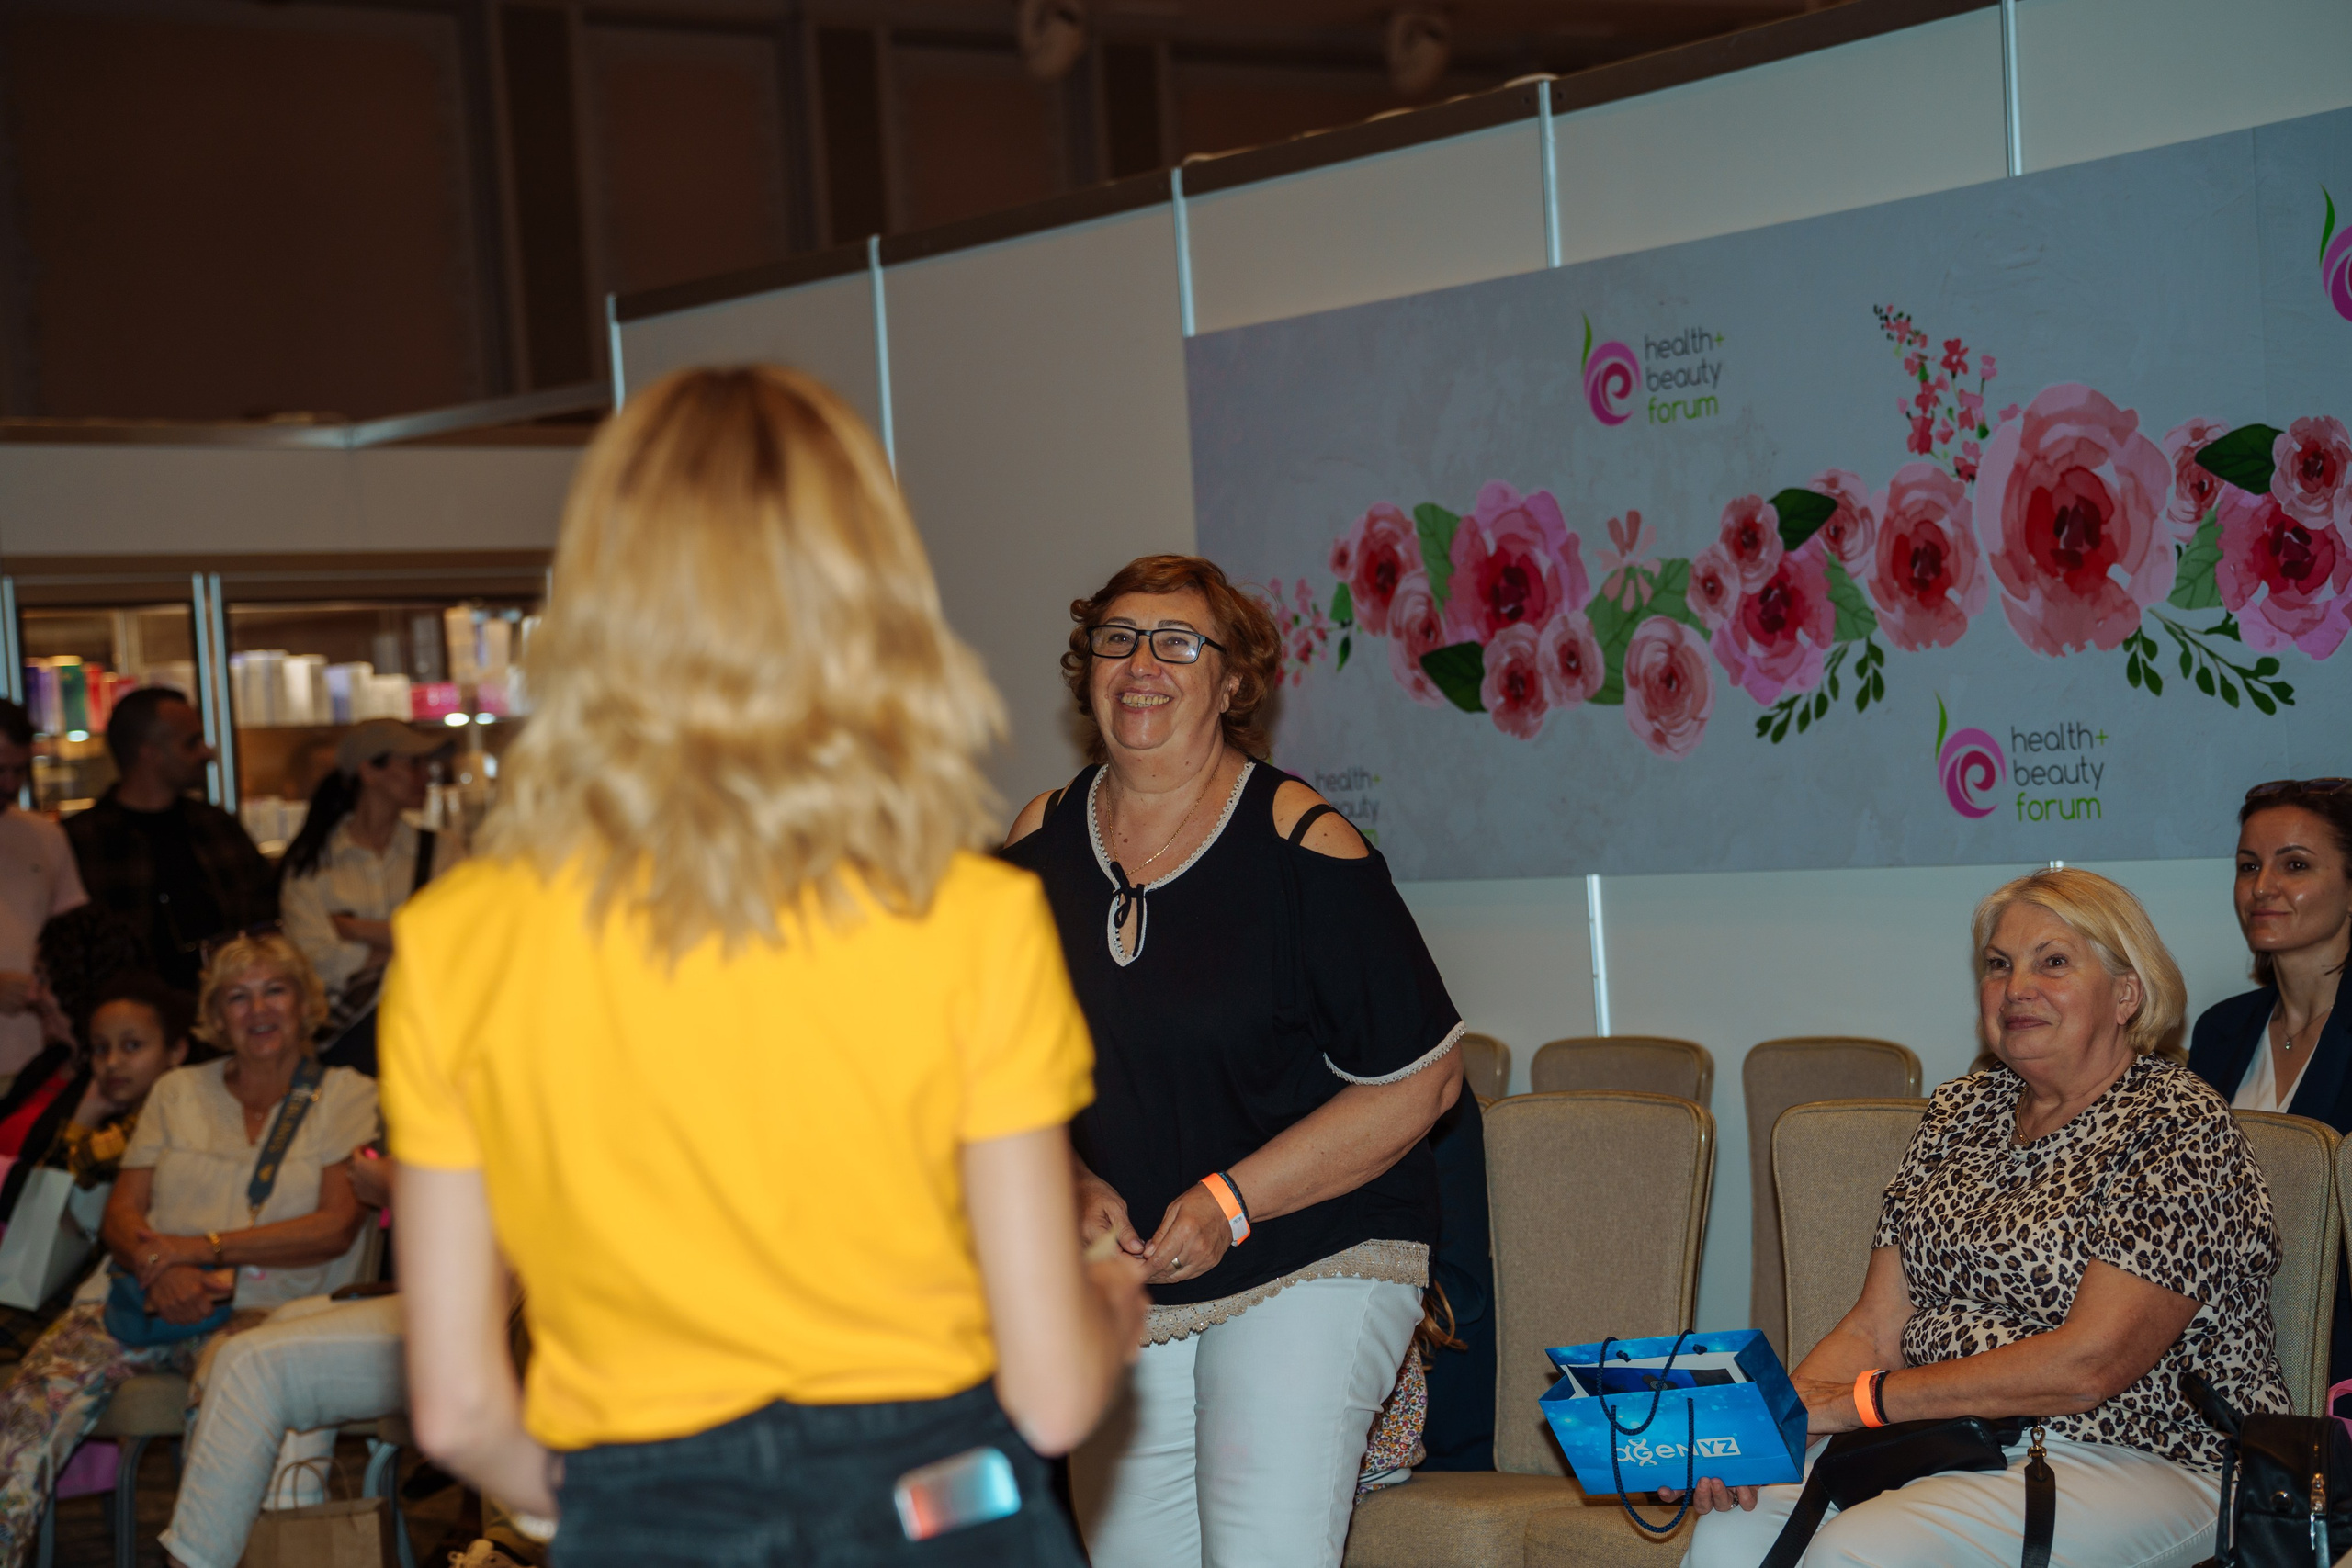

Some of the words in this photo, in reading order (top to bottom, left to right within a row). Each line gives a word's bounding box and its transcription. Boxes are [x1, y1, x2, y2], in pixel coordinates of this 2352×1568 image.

[1644, 325, 1725, 360] health+
[1645, 357, 1723, 392] beauty
[1647, 395, 1719, 424] forum
[2010, 721, 2109, 753] health+
[2013, 755, 2105, 791] beauty
[2016, 792, 2102, 822] forum
